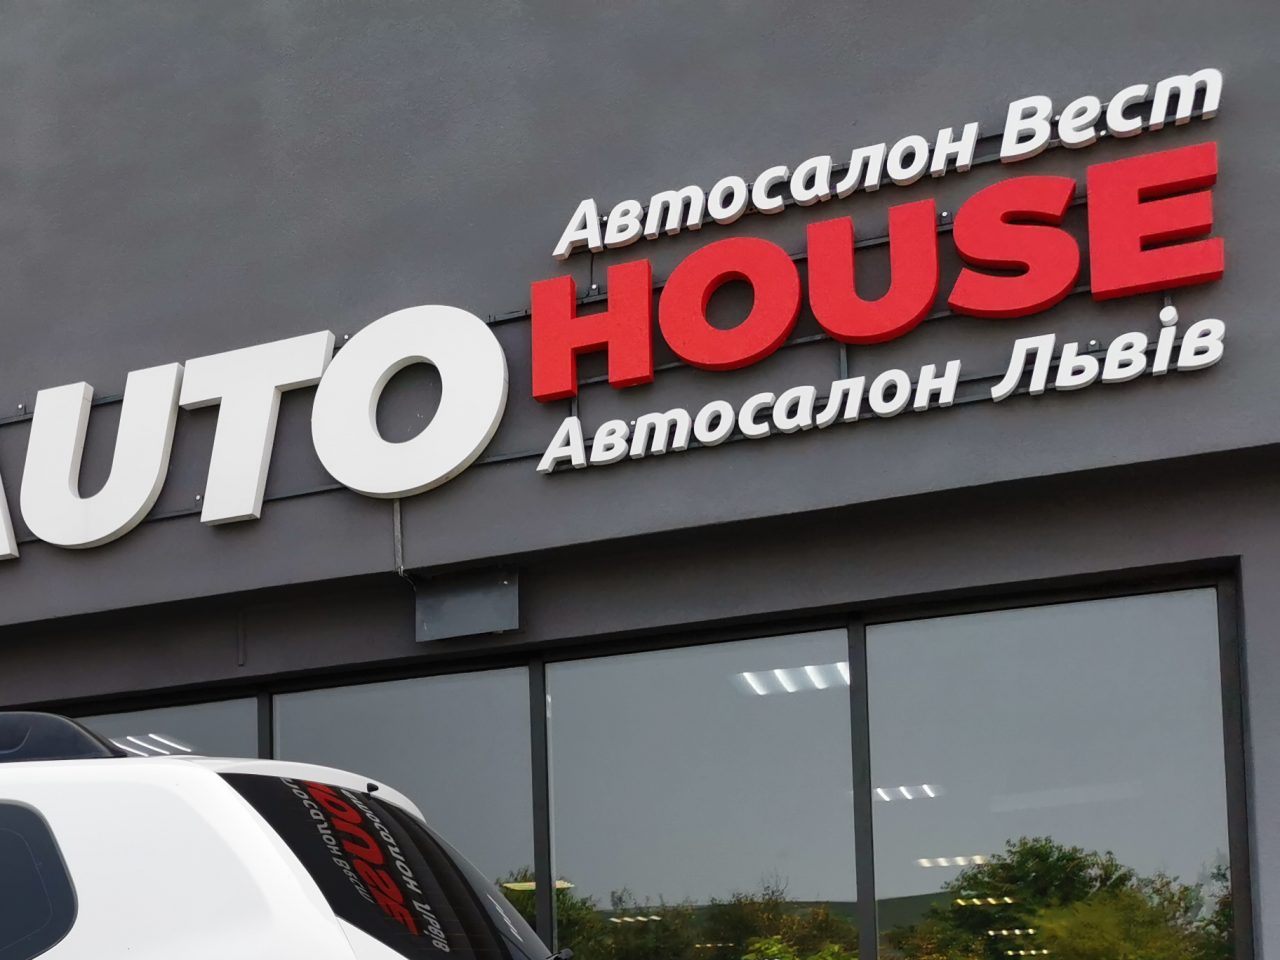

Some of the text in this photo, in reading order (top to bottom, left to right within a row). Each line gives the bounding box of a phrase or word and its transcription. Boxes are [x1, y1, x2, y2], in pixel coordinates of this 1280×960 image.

[552, 67, 1225, 261] Автосалон Вест
[530, 140, 1226, 404] HOUSE
[536, 304, 1226, 475] Автосалон Львів
